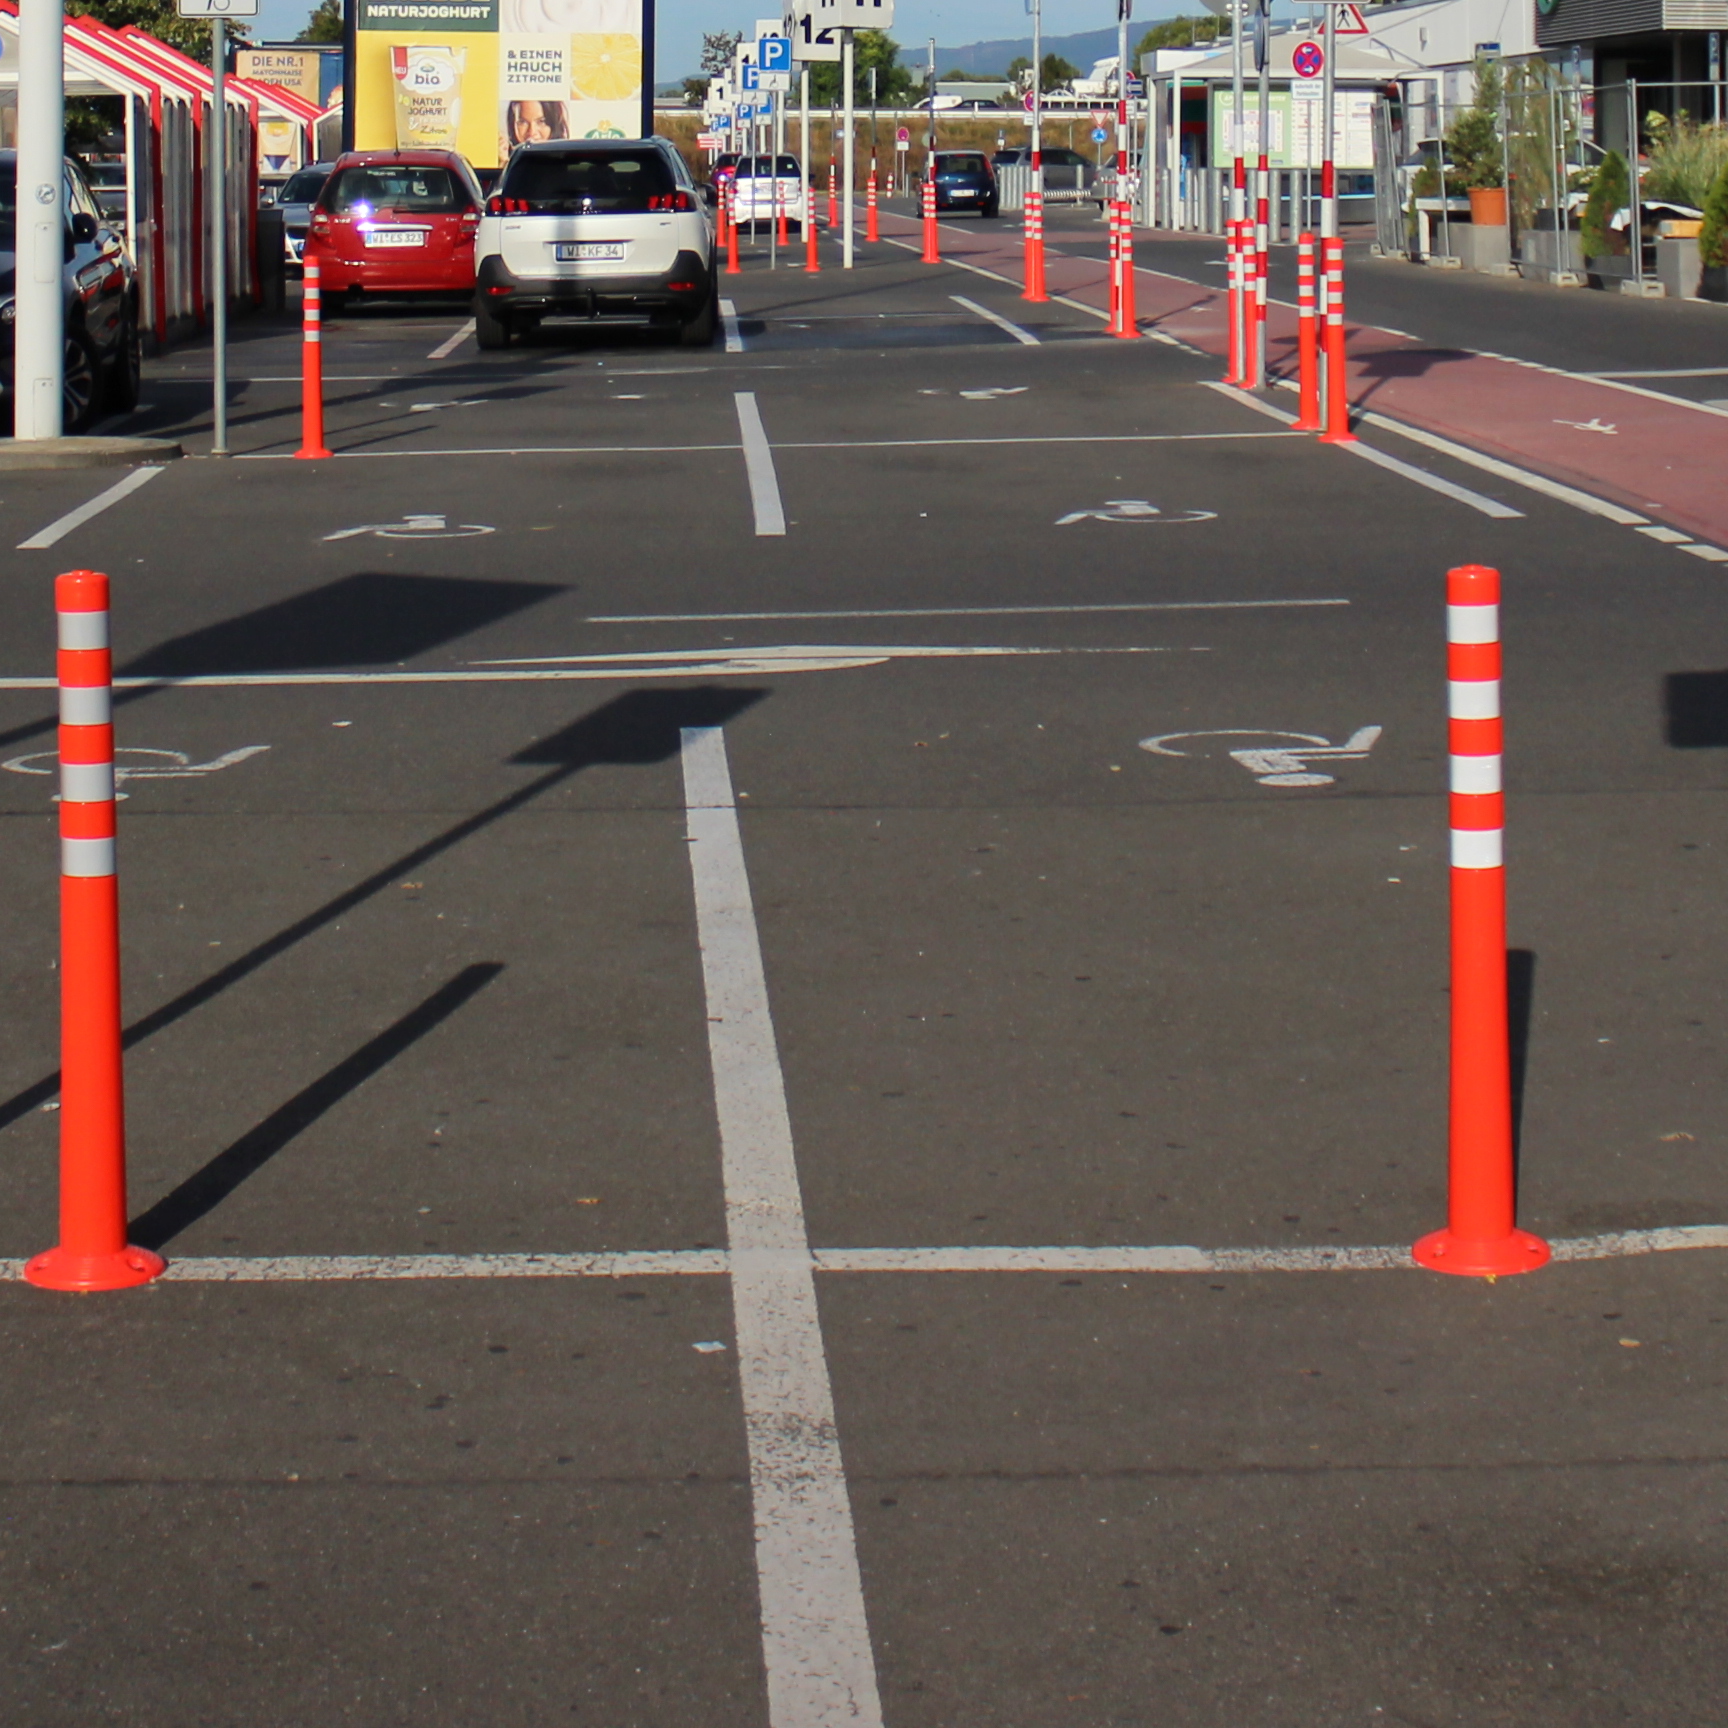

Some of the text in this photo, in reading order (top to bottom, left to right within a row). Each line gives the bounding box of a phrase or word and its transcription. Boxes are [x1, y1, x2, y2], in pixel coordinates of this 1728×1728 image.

[367, 5, 491, 19] NATURJOGHURT
[520, 50, 563, 60] EINEN
[765, 42, 783, 67] P
[252, 56, 273, 66] DIE
[507, 61, 563, 73] HAUCH
[284, 78, 302, 86] USA
[414, 74, 441, 85] bio
[507, 74, 563, 84] ZITRONE
[412, 97, 443, 106] NATUR
[408, 107, 448, 116] JOGHURT
[740, 105, 749, 117] P
[588, 245, 602, 256] KF
[605, 245, 619, 255] 34
